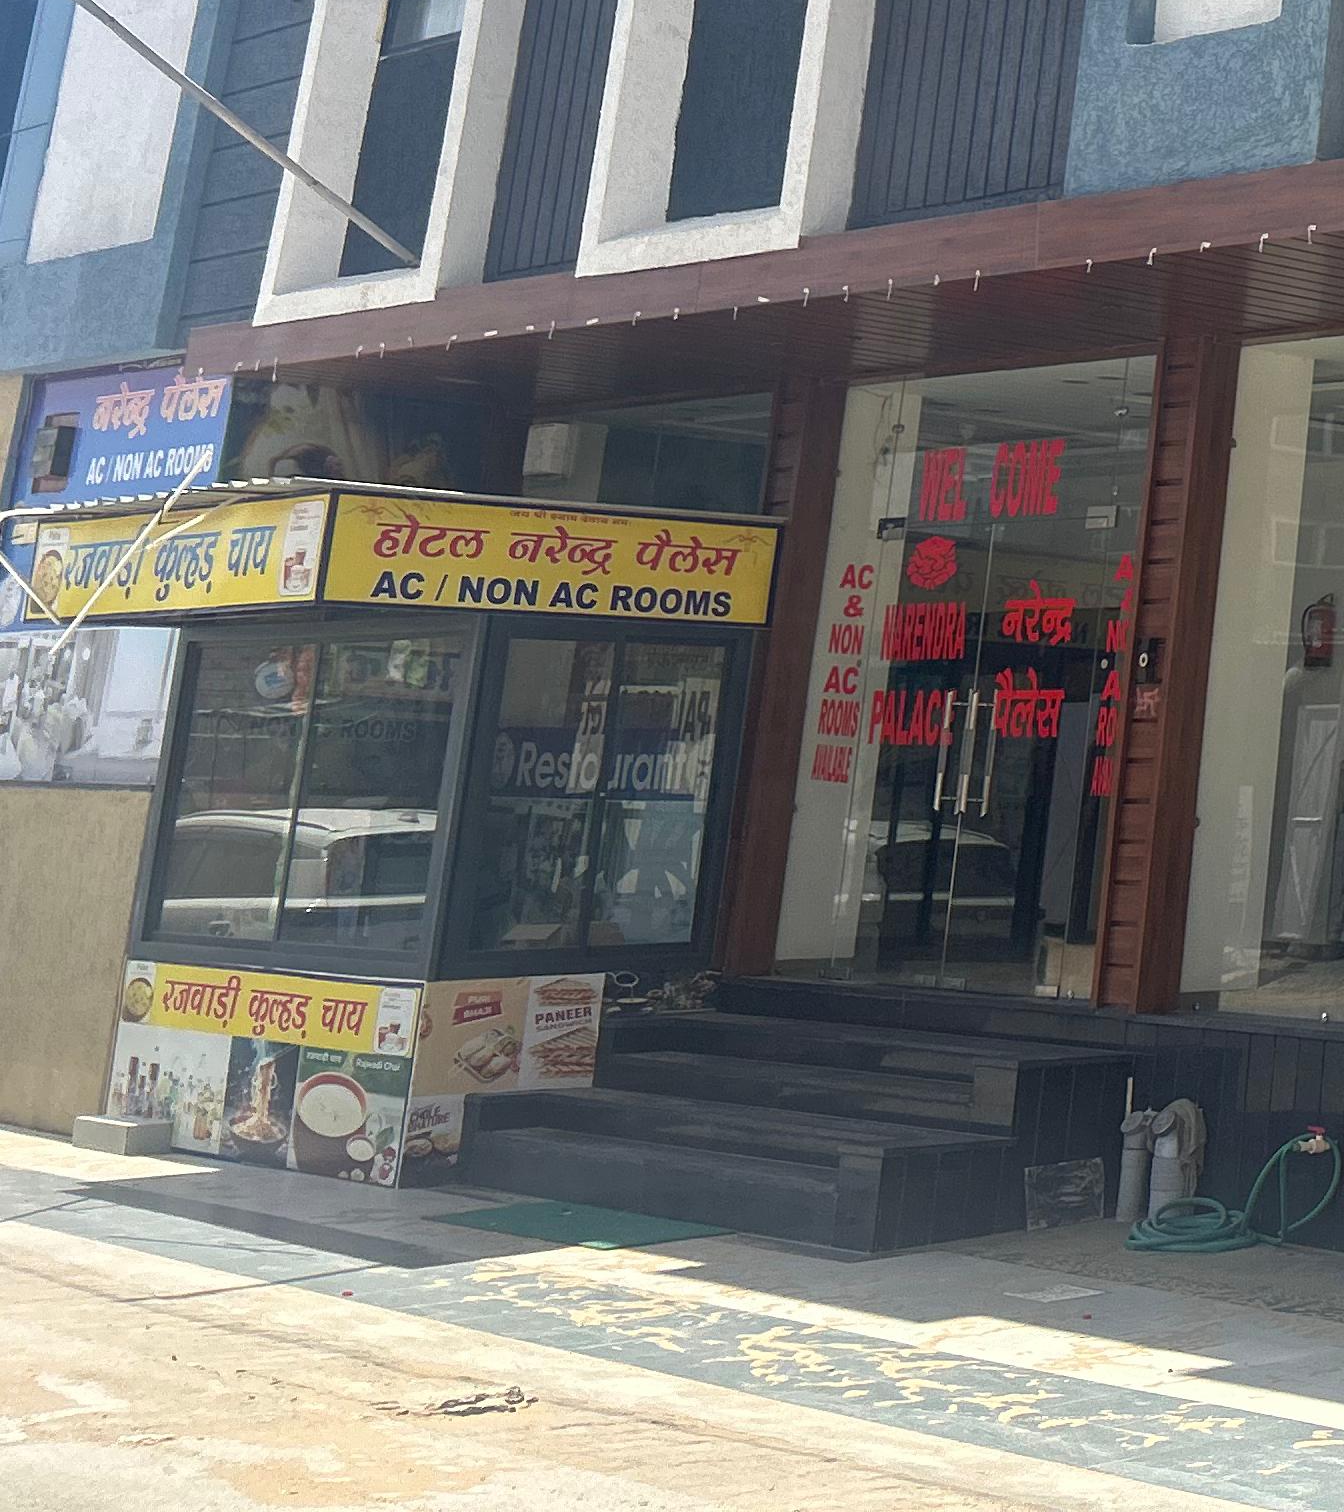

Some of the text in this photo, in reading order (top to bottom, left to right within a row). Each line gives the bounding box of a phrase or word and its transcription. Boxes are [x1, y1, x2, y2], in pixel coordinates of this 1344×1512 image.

[86, 457, 105, 486] AC
[113, 453, 142, 483] NON
[144, 451, 164, 478] AC
[154, 531, 221, 602] कुल्हड़
[228, 525, 277, 576] चाय
[373, 512, 491, 560] होटल
[508, 526, 618, 576] नरेन्द्र
[636, 529, 742, 576] पैलेस
[840, 564, 874, 589] AC
[1116, 553, 1134, 580] A
[370, 571, 732, 618] AC / NON AC ROOMS
[843, 595, 864, 617] &
[1002, 579, 1077, 645] नरेन्द्र
[829, 624, 864, 655] NON
[881, 601, 966, 661] NARENDRA
[824, 665, 859, 695] AC
[817, 699, 860, 738] ROOMS
[994, 667, 1065, 738] पैलेस
[162, 975, 368, 1039] रजवाड़ी कुल्हड़ चाय
[535, 1006, 592, 1025] PANEER
